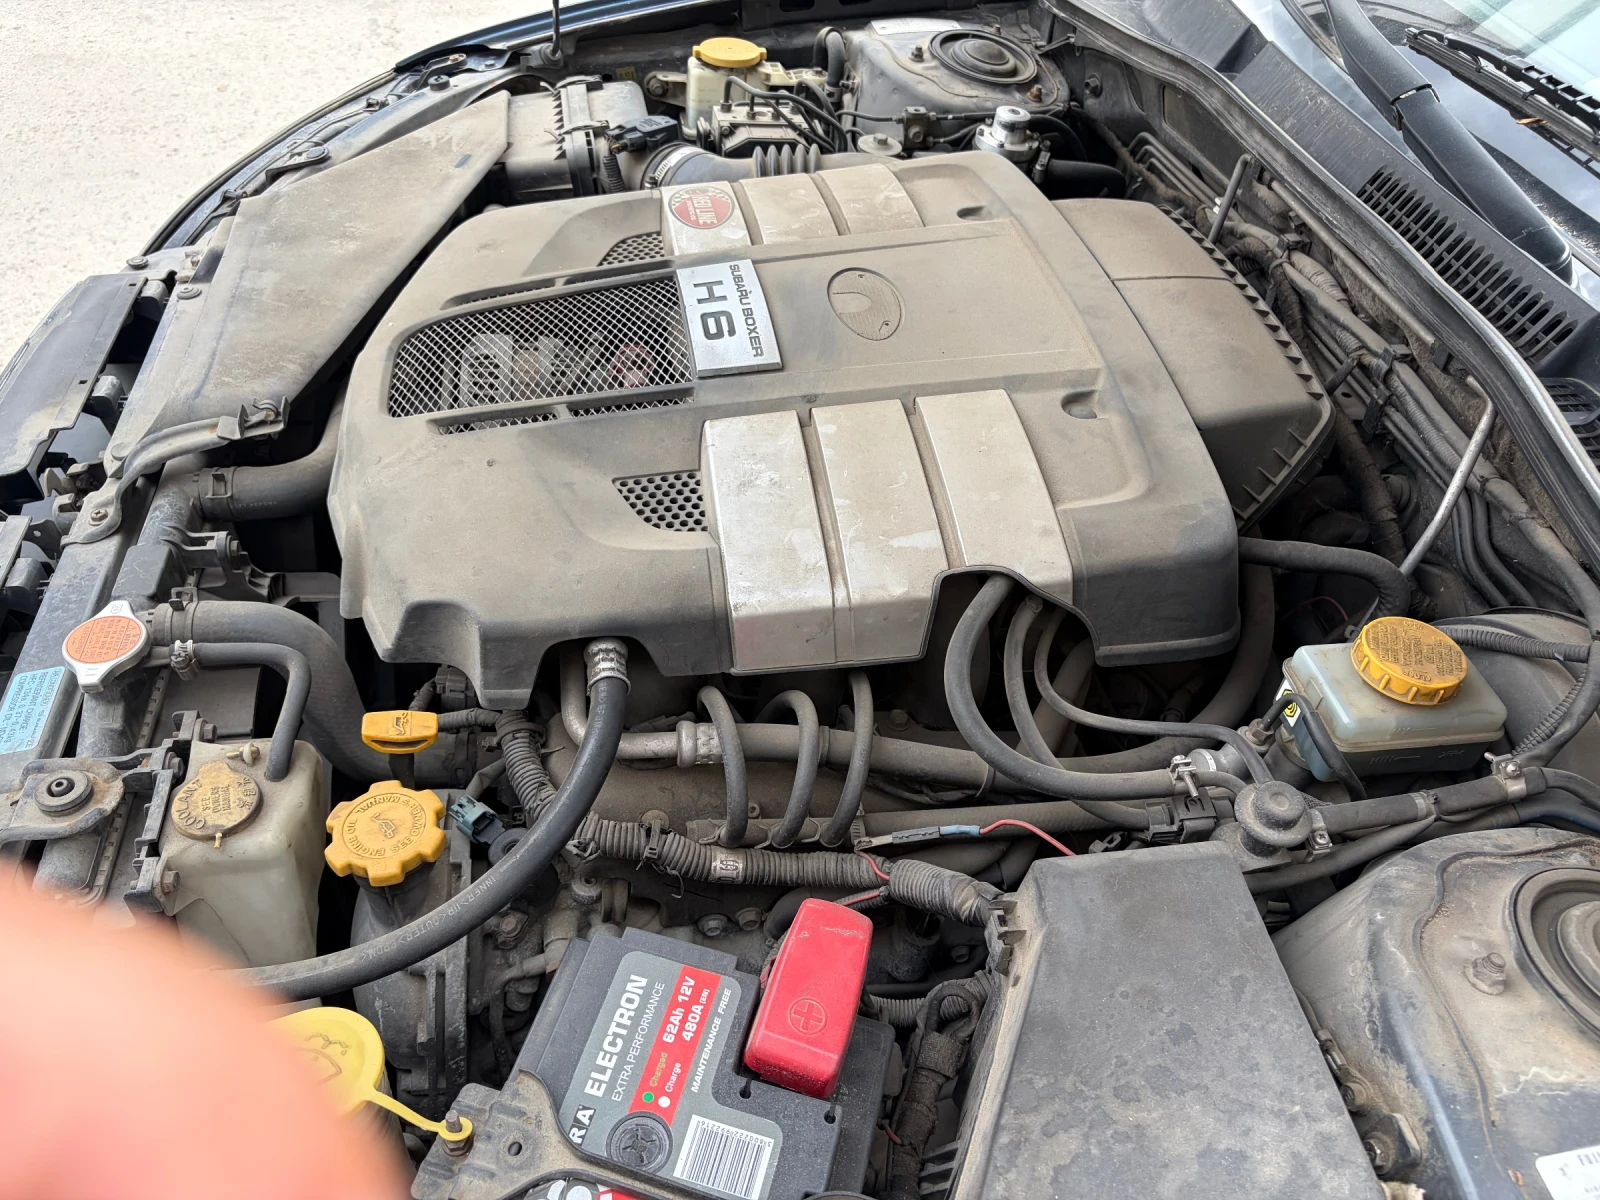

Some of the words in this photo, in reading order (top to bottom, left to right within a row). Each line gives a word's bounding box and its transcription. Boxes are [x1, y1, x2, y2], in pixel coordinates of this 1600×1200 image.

[693, 280, 737, 341] H6
[729, 264, 750, 308] SUBARU
[742, 308, 765, 358] BOXER
[176, 779, 205, 829] COOLANT
[201, 797, 211, 811] SEE
[355, 795, 400, 814] MANUAL
[346, 819, 358, 834] OIL
[390, 836, 413, 853] SEE
[348, 835, 386, 857] ENGINE
[662, 1007, 685, 1043] 62Ah
[677, 975, 695, 1003] 12V
[681, 1005, 704, 1042] 480A
[584, 974, 649, 1098] ELECTRON
[611, 1064, 635, 1102] EXTRA
[626, 981, 665, 1065] PERFORMANCE
[691, 1016, 722, 1093] MAINTENANCE
[717, 988, 732, 1015] FREE
[649, 1052, 668, 1087] Charged
[664, 1062, 681, 1093] Charge
